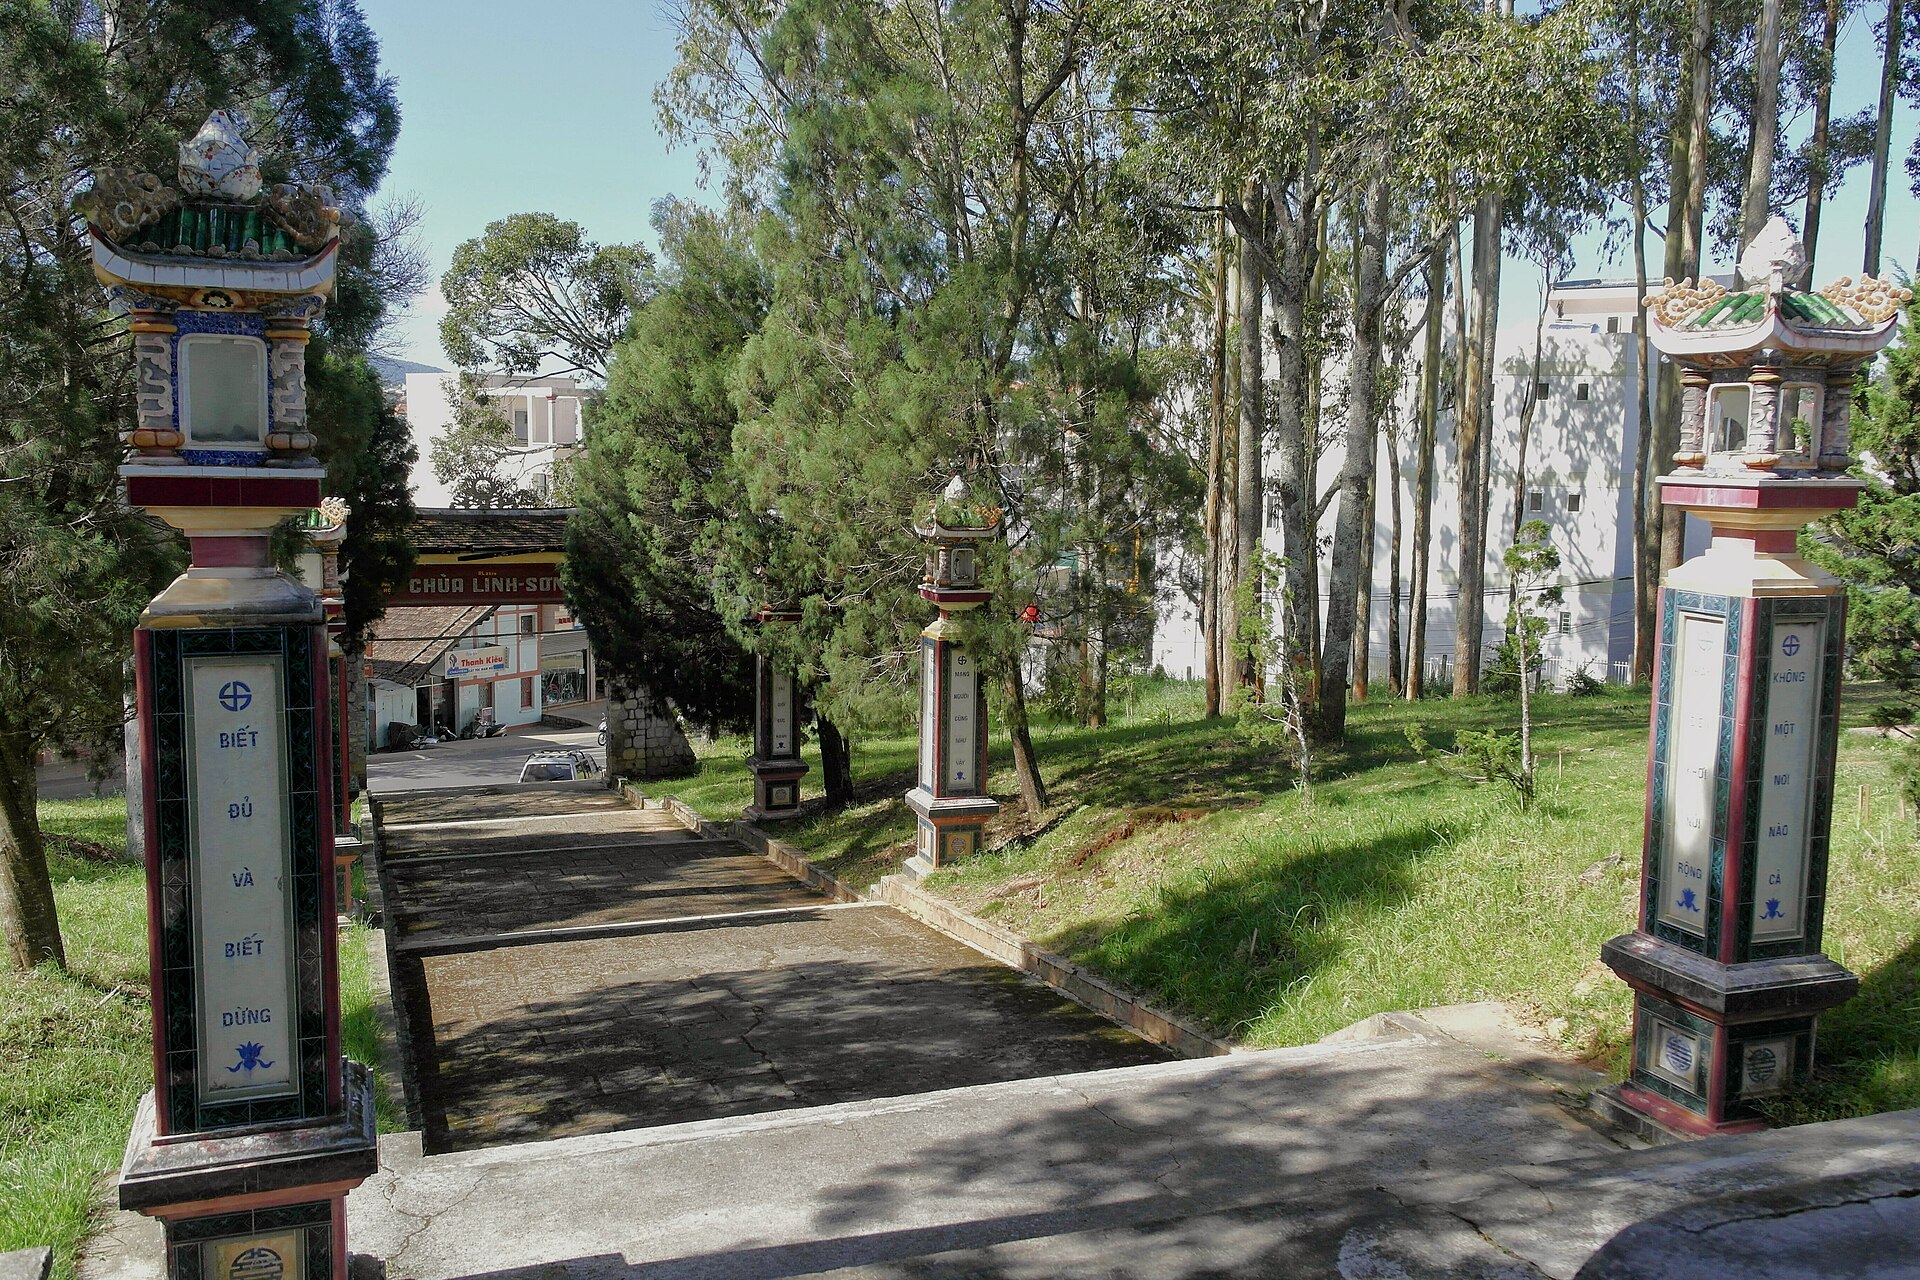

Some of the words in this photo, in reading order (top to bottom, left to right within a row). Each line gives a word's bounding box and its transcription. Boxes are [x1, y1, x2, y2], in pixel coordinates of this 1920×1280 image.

[409, 573, 464, 593] CHÙA
[461, 657, 484, 667] Thanh
[1773, 668, 1805, 683] KHÔNG
[219, 724, 259, 749] BIẾT
[1774, 720, 1795, 738] MỘT
[227, 795, 253, 819] ĐỦ
[1768, 822, 1789, 837] NÀO
[232, 866, 254, 888] VÀ
[1677, 861, 1702, 880] RỘNG
[224, 932, 264, 958] BIẾT
